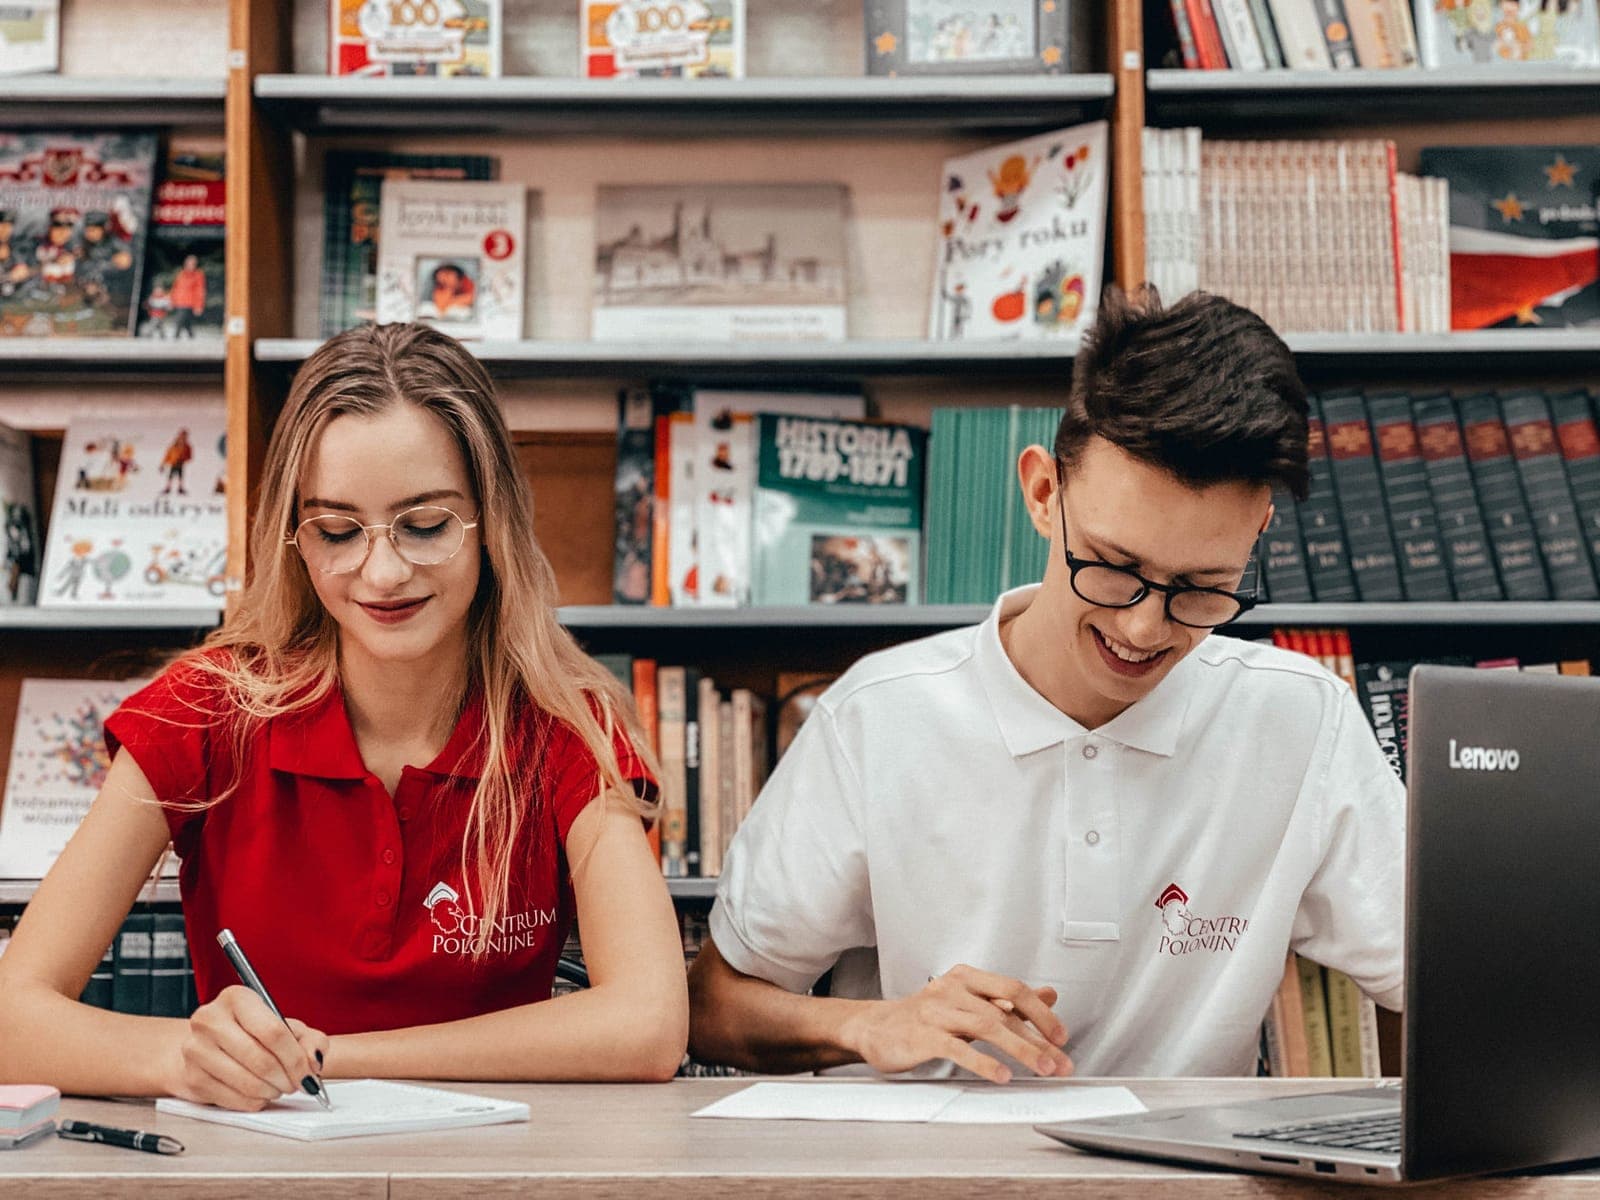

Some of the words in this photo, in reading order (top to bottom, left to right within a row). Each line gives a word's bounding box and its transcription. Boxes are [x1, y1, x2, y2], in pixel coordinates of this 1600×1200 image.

[1019, 216, 1088, 248] roku
[775, 417, 914, 460] HISTORIA
[778, 449, 909, 487] 1789-1871
[66, 498, 120, 518] Mali
[1449, 738, 1520, 771] Lenovo
[432, 929, 535, 955] POLONIJNE
